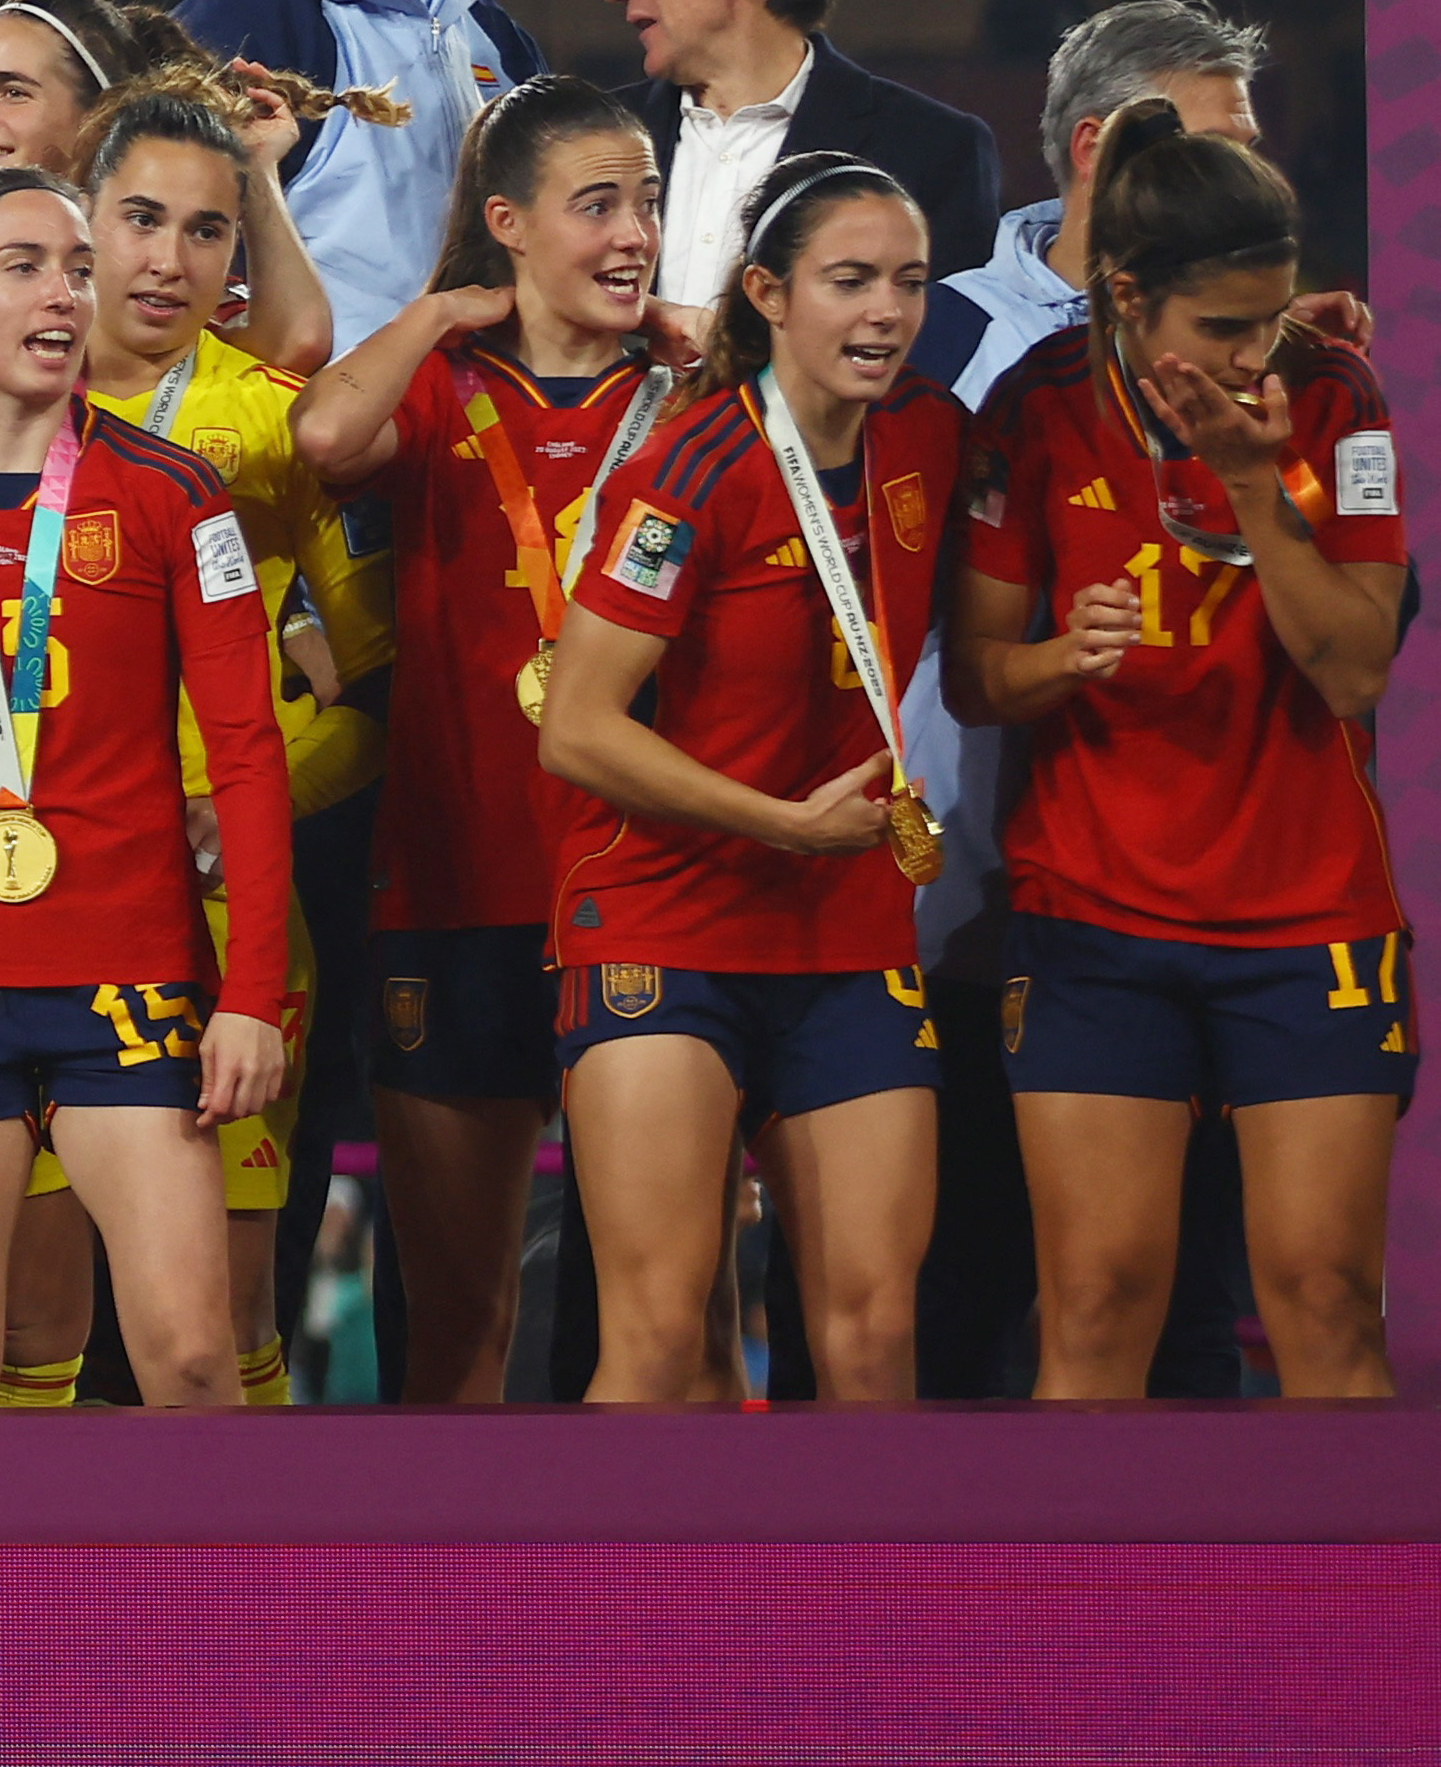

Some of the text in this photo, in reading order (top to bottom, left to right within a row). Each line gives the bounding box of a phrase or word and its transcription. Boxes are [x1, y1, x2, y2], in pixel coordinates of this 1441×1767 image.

[152, 385, 177, 424] WORLD
[627, 422, 642, 442] CUP
[782, 446, 801, 480] FIFA
[792, 475, 825, 537] WOMEN'S
[817, 535, 844, 584] WORLD
[835, 583, 853, 612] CUP
[1123, 542, 1239, 647] 17
